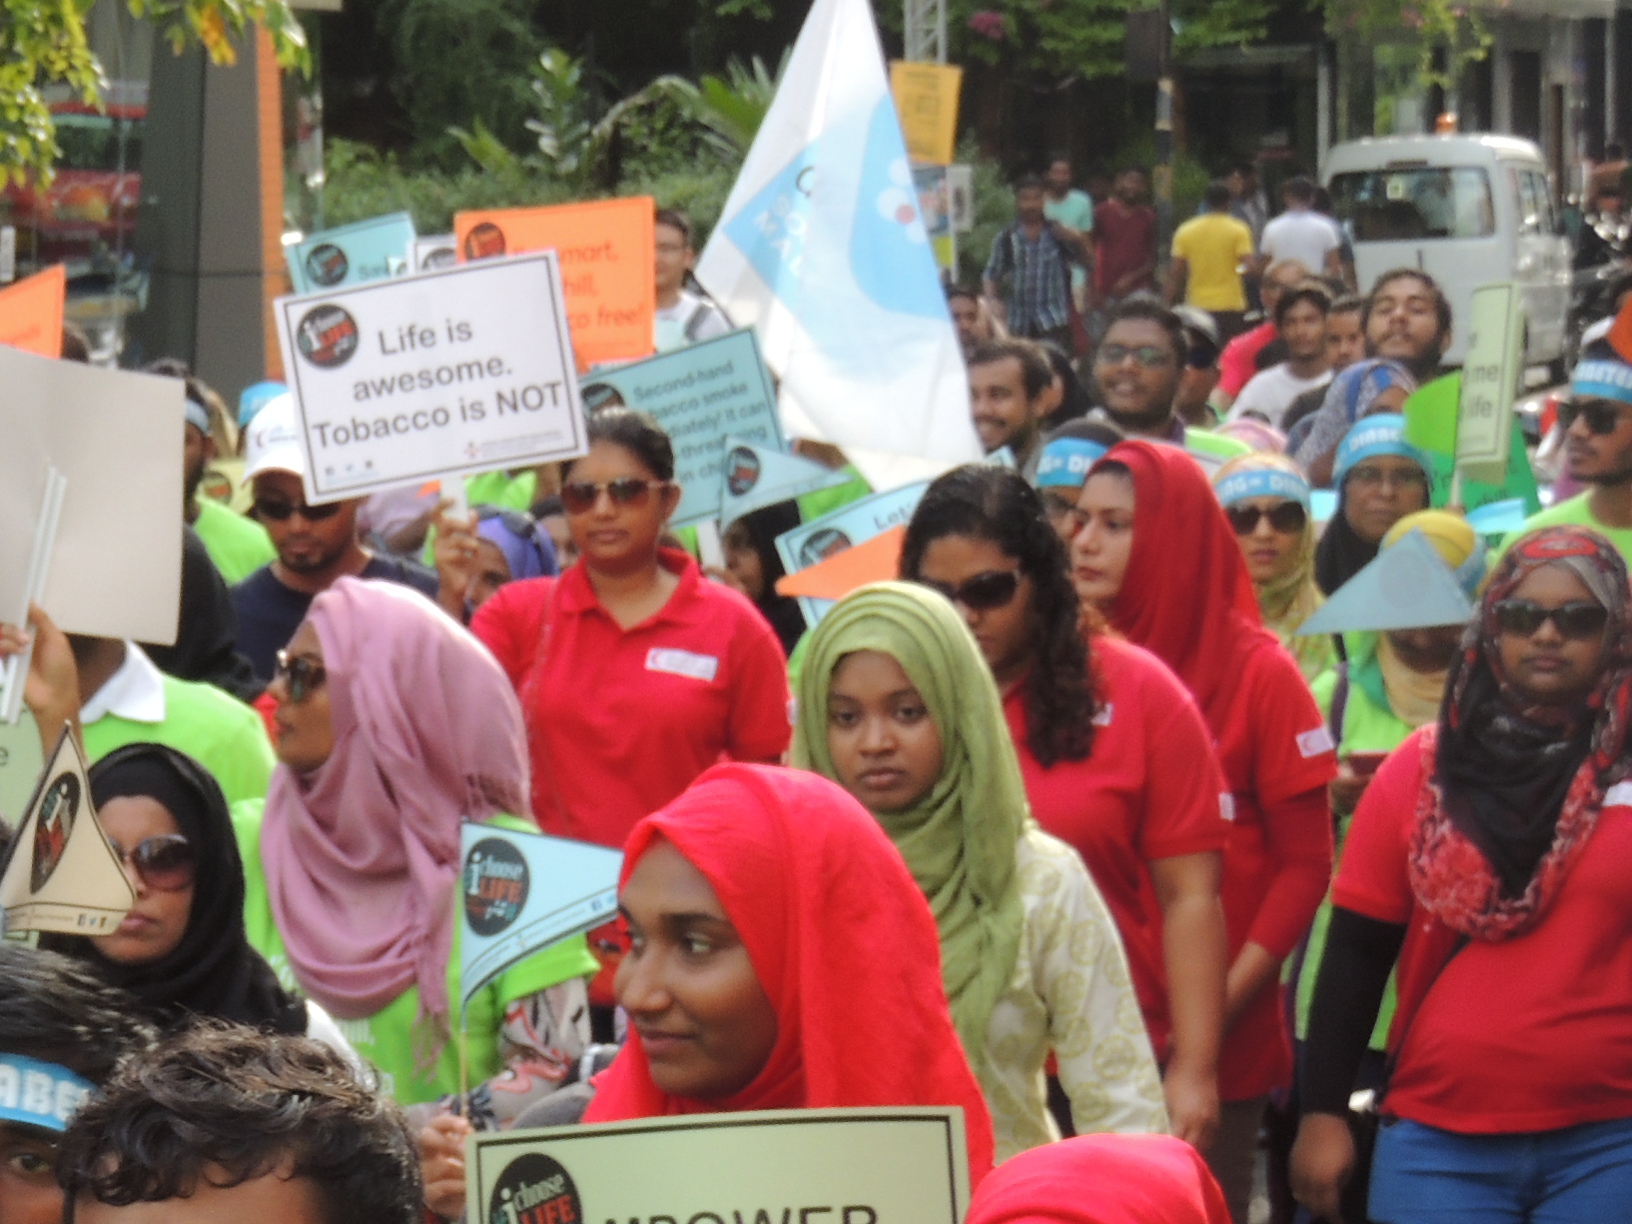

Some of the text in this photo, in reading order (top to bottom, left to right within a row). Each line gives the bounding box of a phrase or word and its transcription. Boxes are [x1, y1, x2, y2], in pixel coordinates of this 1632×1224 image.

[378, 319, 473, 356] Life is
[353, 357, 513, 402] awesome.
[313, 406, 451, 448] Tobacco
[459, 398, 487, 423] is
[496, 382, 563, 416] NOT
